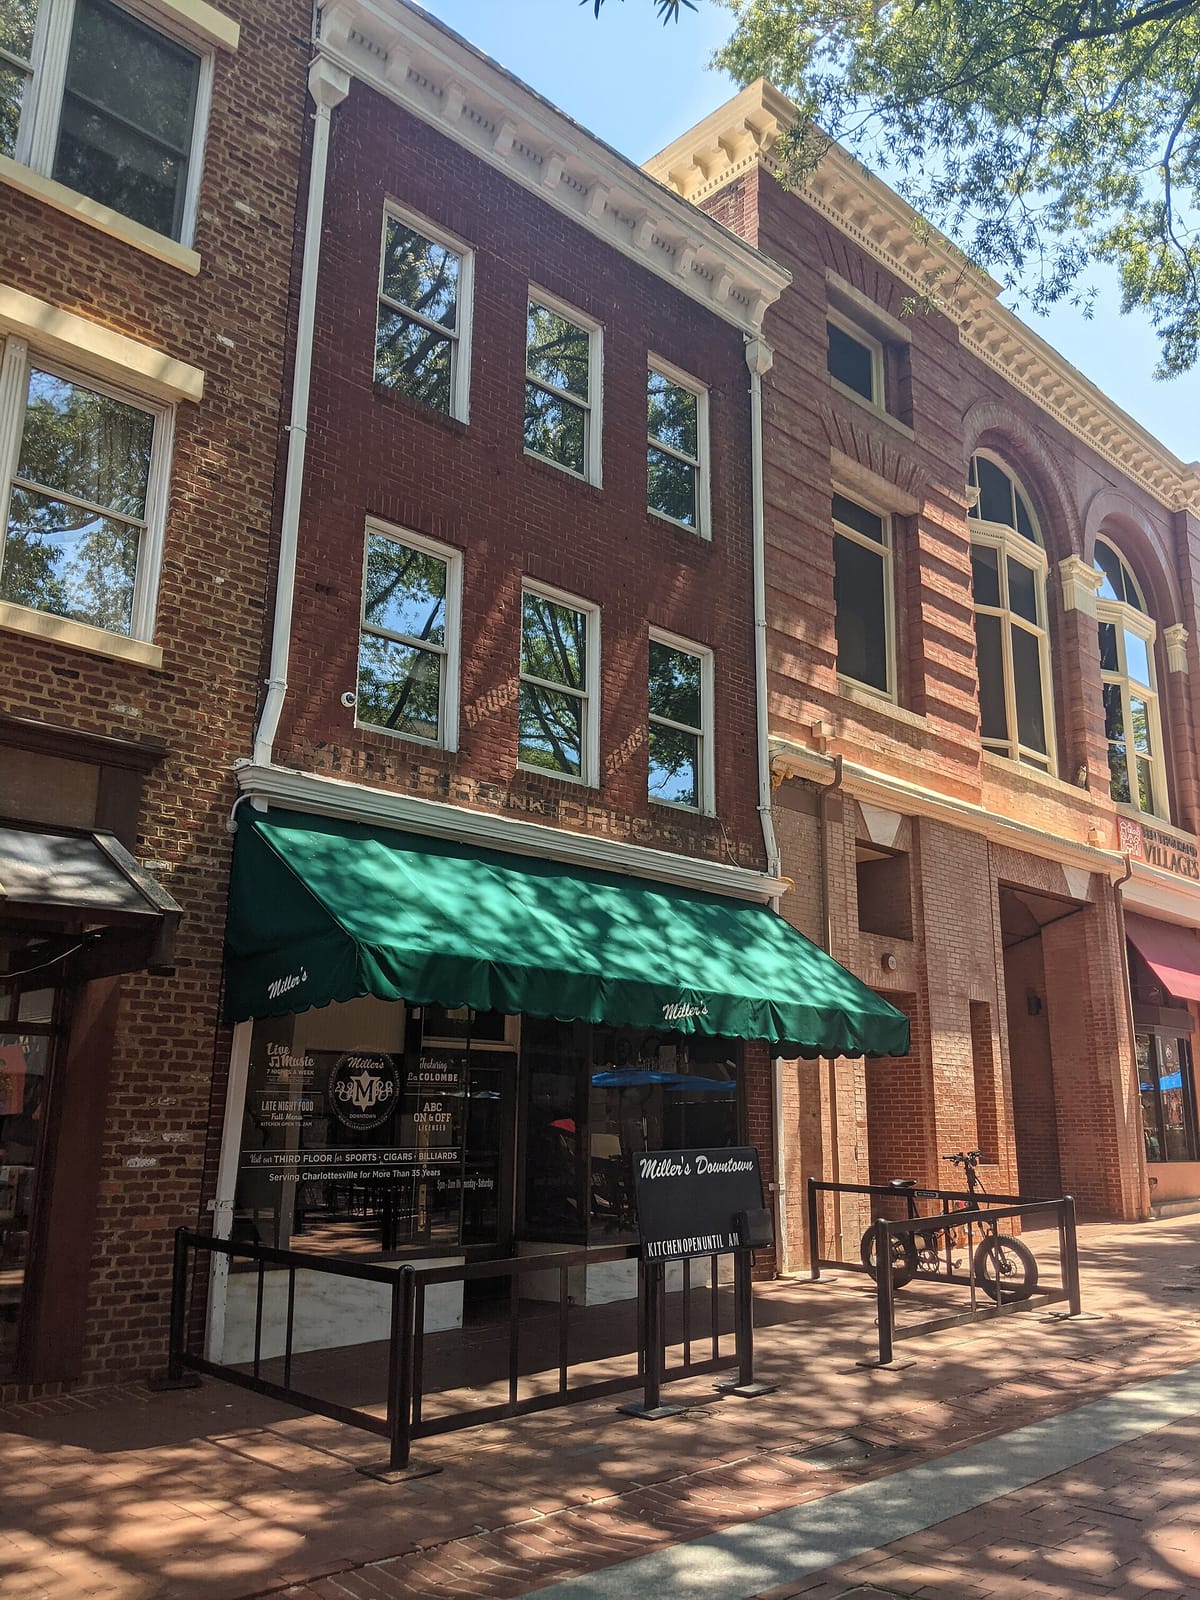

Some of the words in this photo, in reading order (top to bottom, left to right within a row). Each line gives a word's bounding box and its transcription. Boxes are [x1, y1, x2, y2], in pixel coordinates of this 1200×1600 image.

[1143, 841, 1200, 880] VILLAGES
[267, 966, 308, 1000] Miller's
[662, 1000, 709, 1020] Miller's
[266, 1041, 290, 1056] Live
[280, 1054, 315, 1068] Music
[347, 1056, 385, 1069] Miller's
[419, 1073, 459, 1082] COLOMBE
[355, 1079, 375, 1102] M
[261, 1101, 277, 1111] LATE
[278, 1101, 297, 1111] NIGHT
[298, 1101, 314, 1111] FOOD
[423, 1102, 443, 1112] ABC
[413, 1113, 427, 1122] ON
[435, 1113, 452, 1122] OFF
[274, 1154, 301, 1164] THIRD
[303, 1154, 332, 1163] FLOOR
[345, 1153, 377, 1162] SPORTS
[383, 1153, 413, 1161] CIGARS
[419, 1151, 458, 1161] BILLIARDS
[639, 1155, 692, 1179] Miller's
[695, 1155, 754, 1175] Downtown
[269, 1172, 300, 1182] Serving
[302, 1170, 358, 1181] Charlottesville
[360, 1170, 371, 1179] for
[372, 1169, 390, 1178] More
[392, 1169, 410, 1178] Than
[411, 1169, 421, 1177] 35
[422, 1169, 441, 1177] Years
[647, 1238, 682, 1257] KITCHEN
[682, 1236, 702, 1253] OPEN
[702, 1234, 724, 1250] UNTIL
